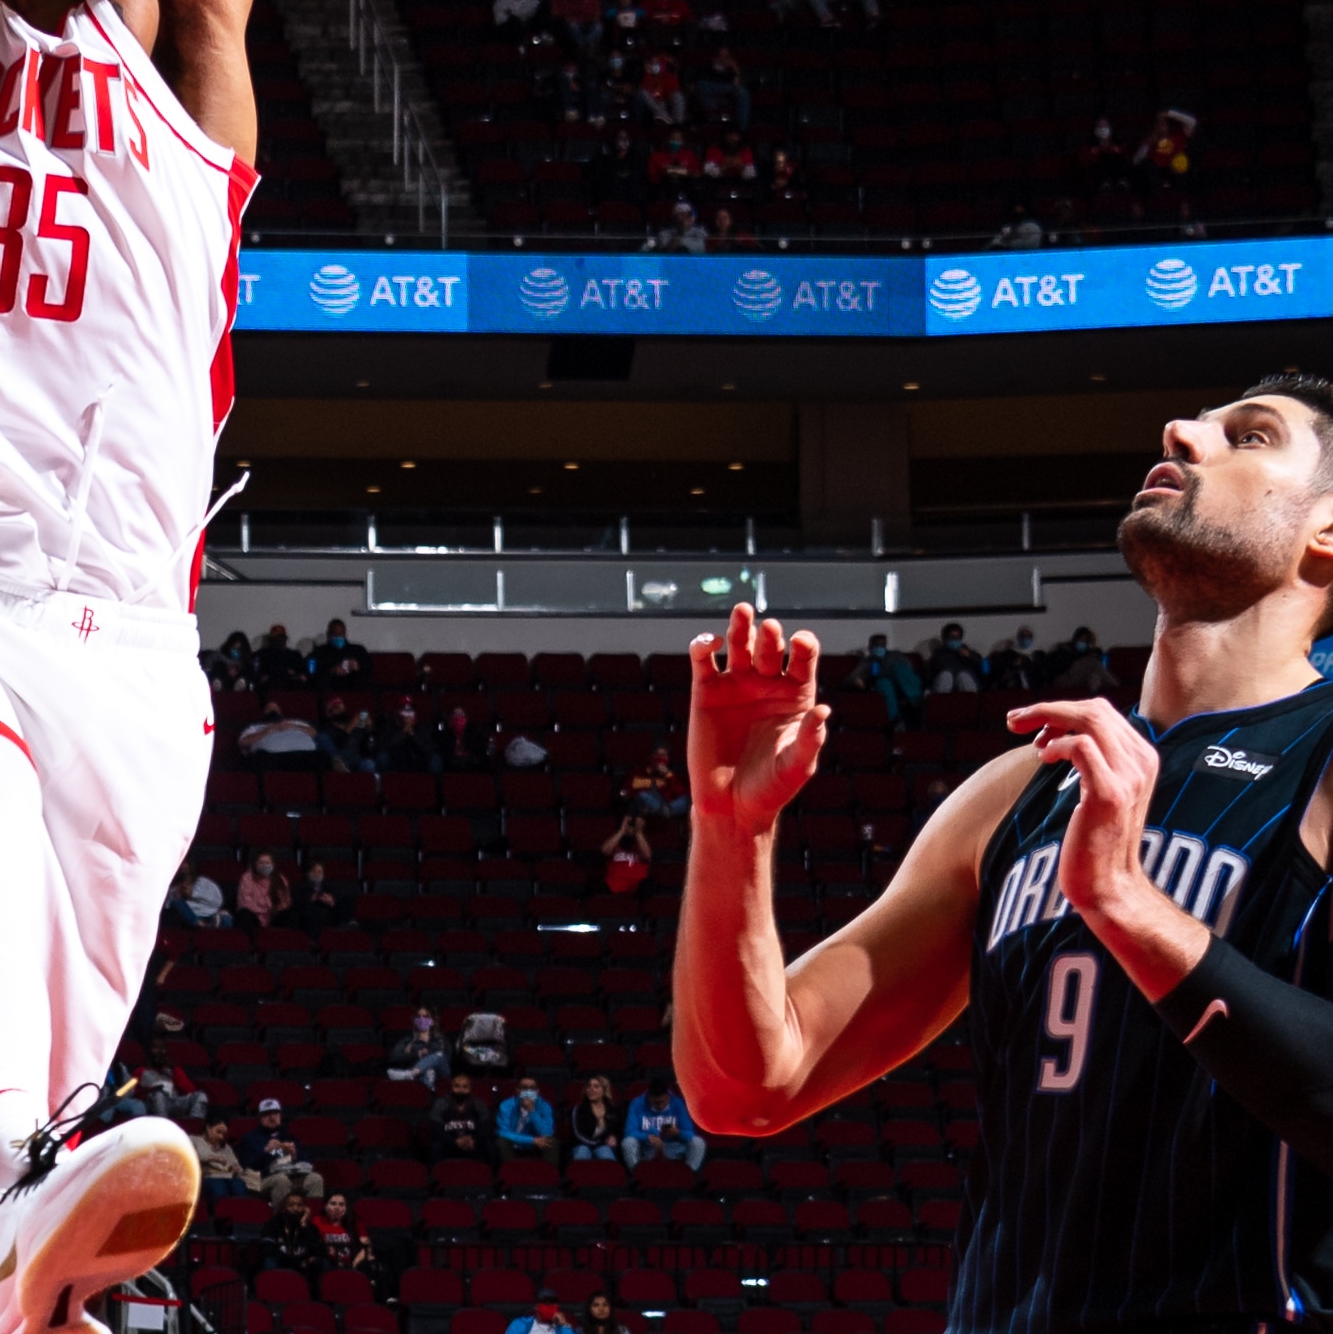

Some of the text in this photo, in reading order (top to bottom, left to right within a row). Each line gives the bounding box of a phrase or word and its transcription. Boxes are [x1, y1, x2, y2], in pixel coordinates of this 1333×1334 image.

[370, 275, 460, 308] AT&T
[580, 278, 670, 312] AT&T
[792, 280, 882, 313] AT&T
[991, 273, 1085, 309] AT&T
[1207, 263, 1303, 298] AT&T
[1036, 951, 1097, 1096] 9
